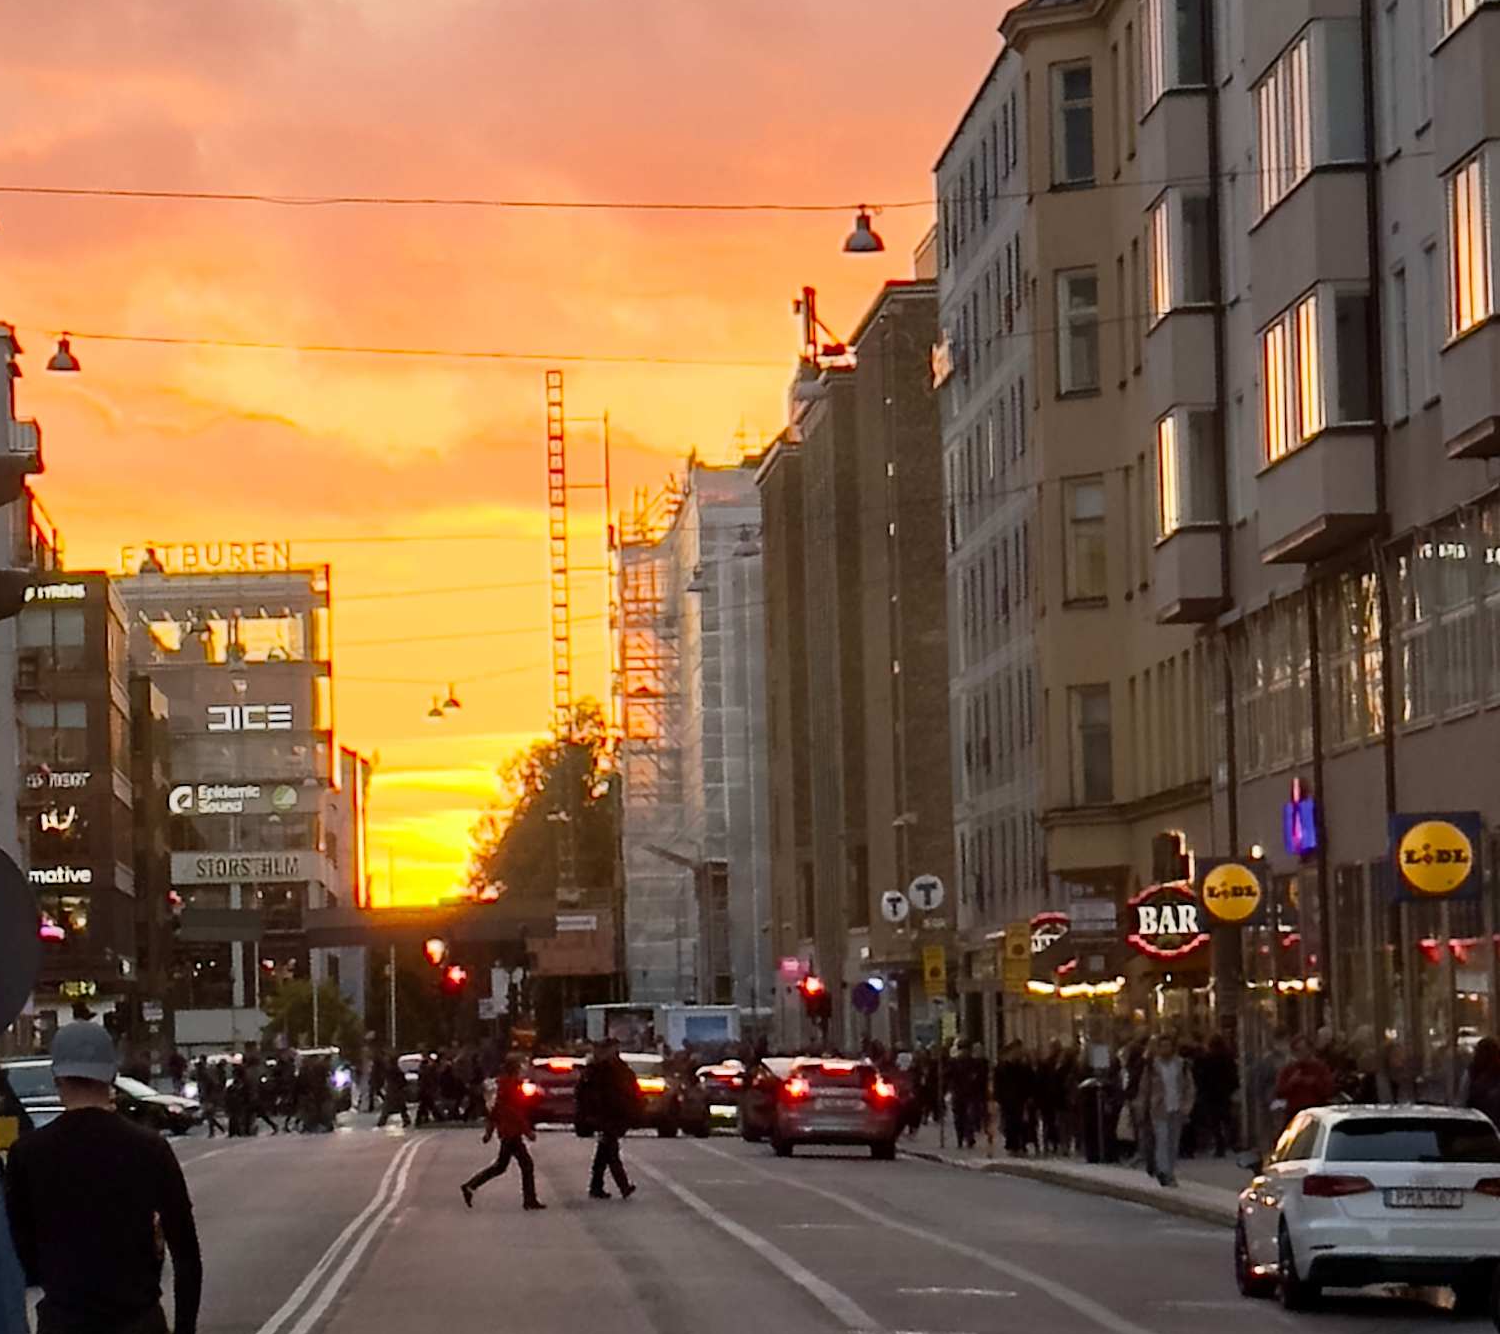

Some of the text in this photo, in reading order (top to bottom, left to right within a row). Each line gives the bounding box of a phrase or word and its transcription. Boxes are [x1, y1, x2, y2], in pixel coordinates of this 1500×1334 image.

[207, 704, 293, 731] DICE
[198, 785, 261, 800] Epidemic
[198, 800, 243, 813] Sound
[1137, 904, 1200, 935] BAR
